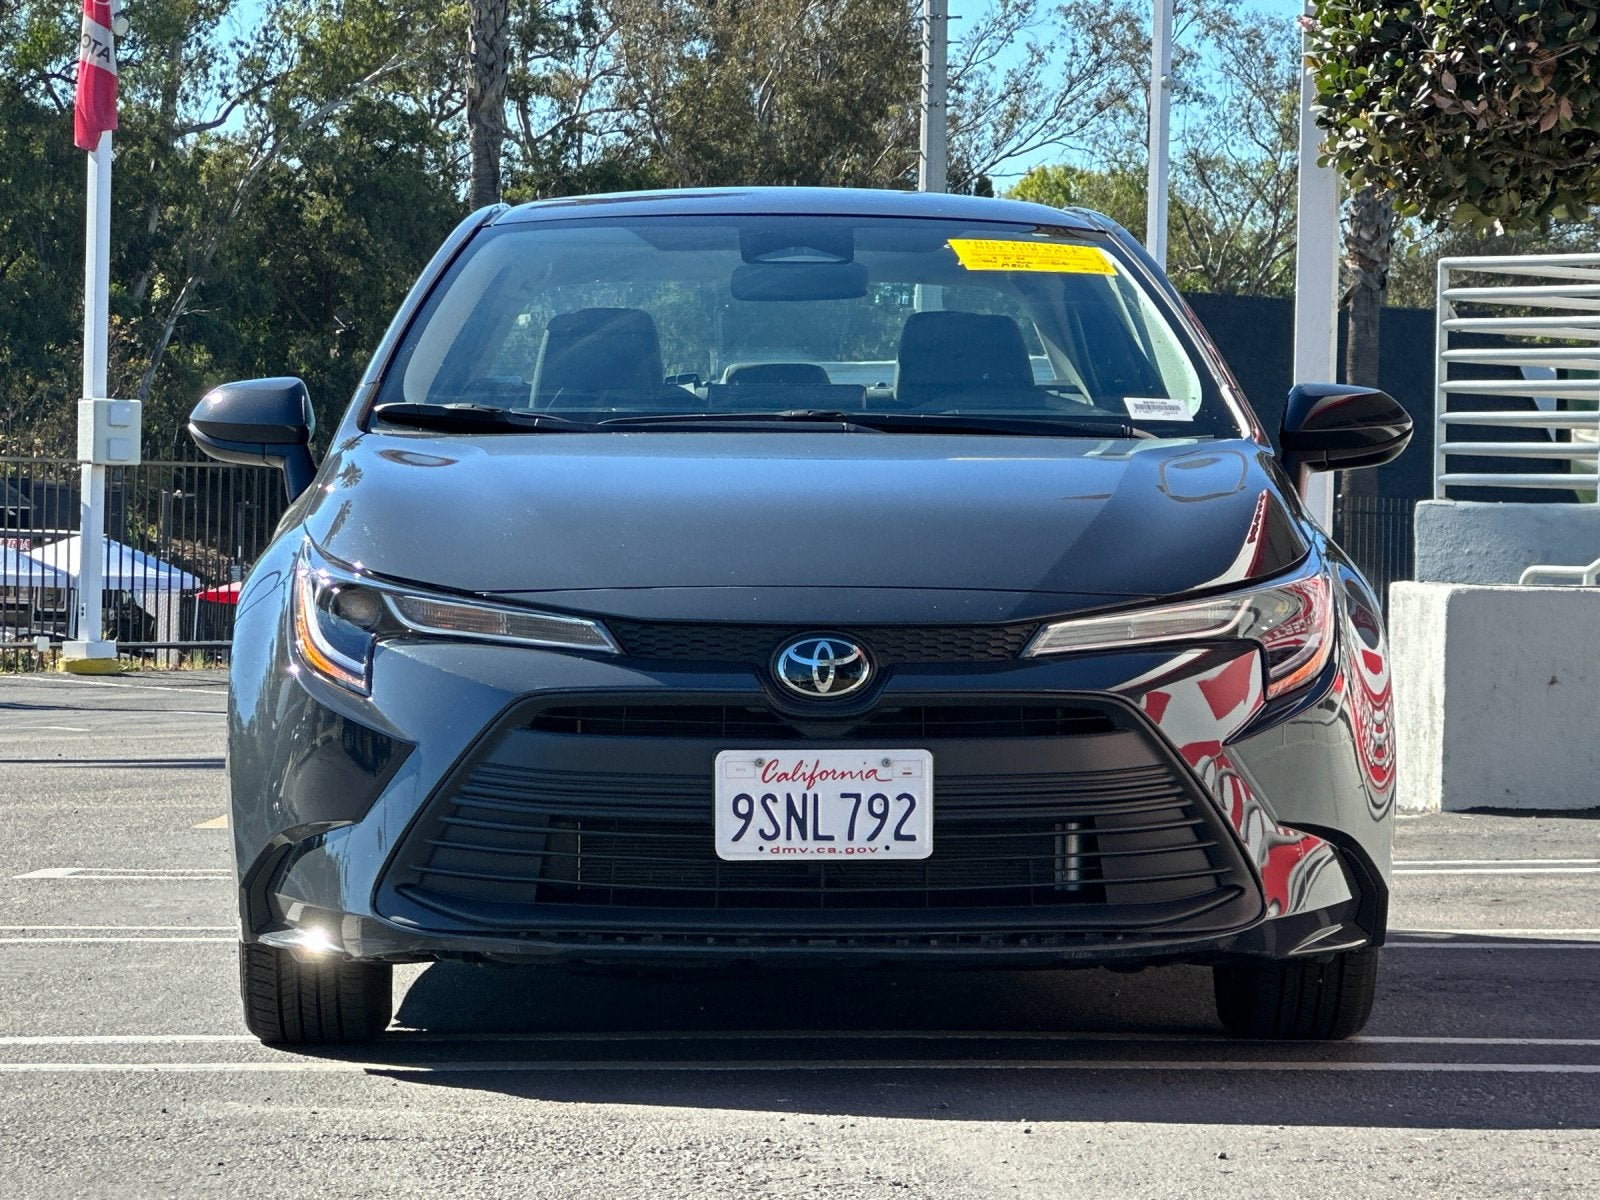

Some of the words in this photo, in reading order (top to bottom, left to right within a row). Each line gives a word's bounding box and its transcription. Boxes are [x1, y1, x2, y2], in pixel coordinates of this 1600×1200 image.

[761, 759, 893, 791] California
[731, 793, 917, 842] 9SNL792
[770, 845, 879, 854] dmv.ca.gov
